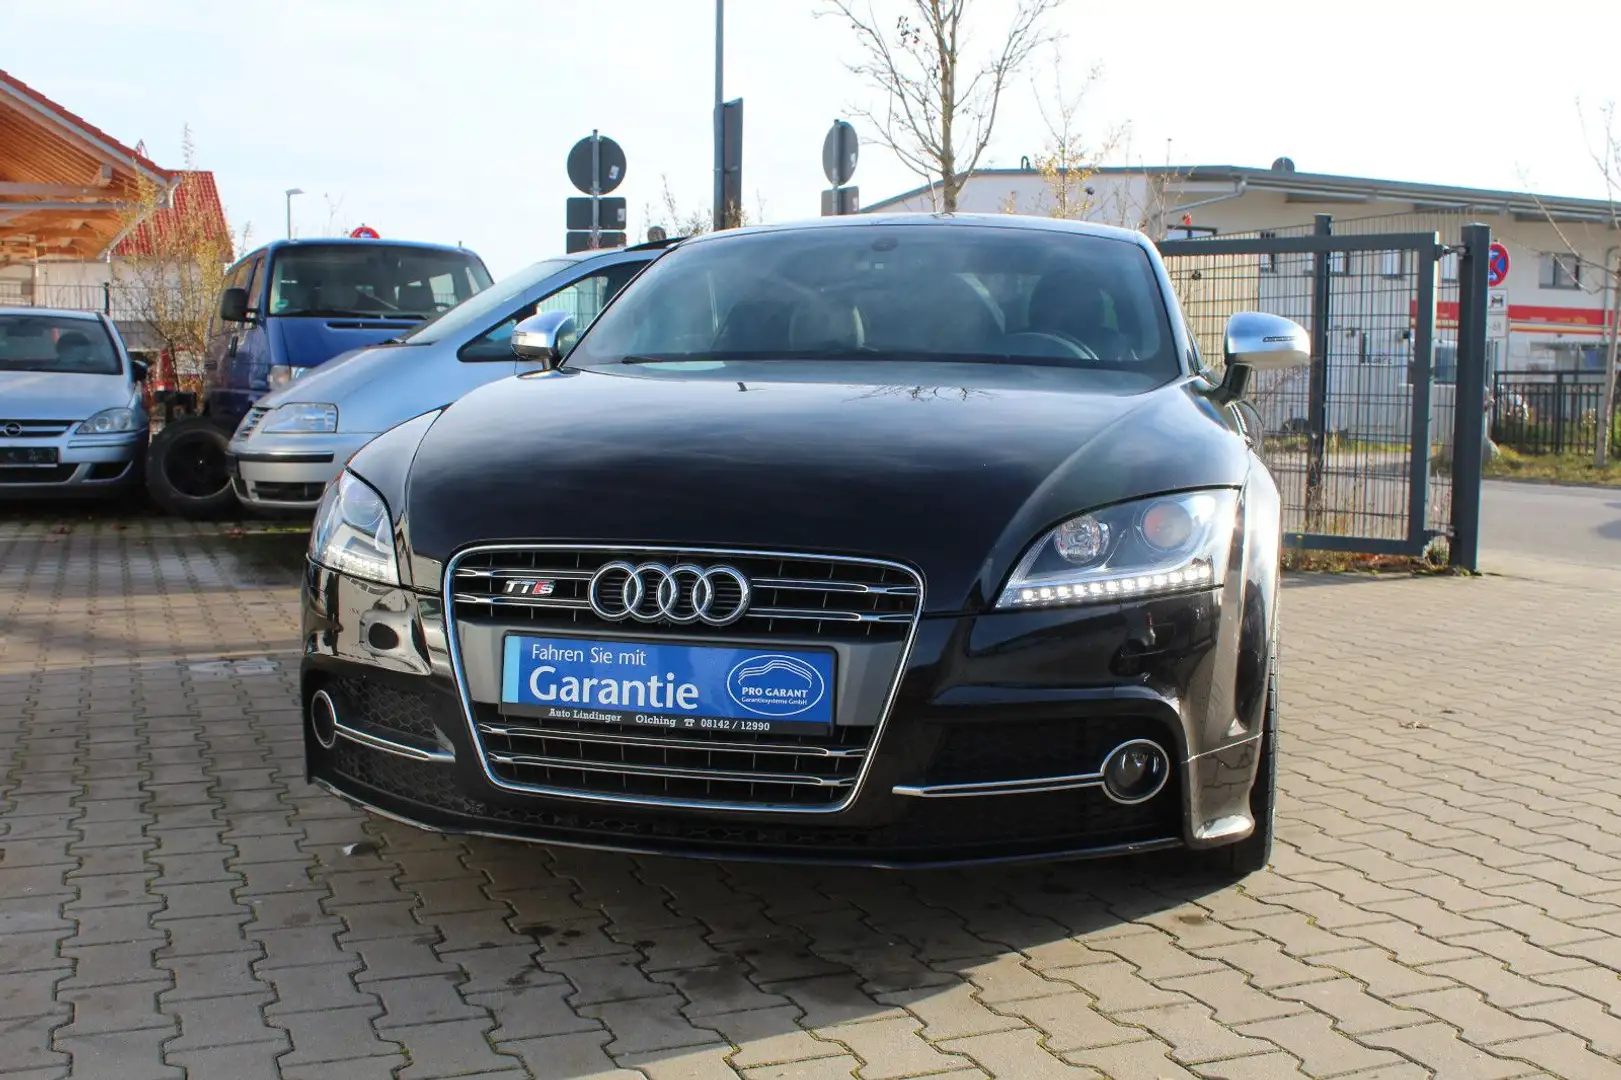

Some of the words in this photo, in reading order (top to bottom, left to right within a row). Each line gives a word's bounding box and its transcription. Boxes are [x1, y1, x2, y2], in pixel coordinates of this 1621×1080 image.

[532, 644, 584, 663] Fahren
[590, 647, 613, 664] Sie
[618, 649, 647, 666] mit
[529, 665, 700, 710] Garantie
[741, 687, 762, 696] PRO
[765, 687, 808, 698] GARANT
[548, 708, 571, 718] Auto
[573, 710, 622, 723] Lindinger
[635, 714, 677, 728] Olching
[701, 718, 730, 729] 08142
[740, 721, 770, 731] 12990
